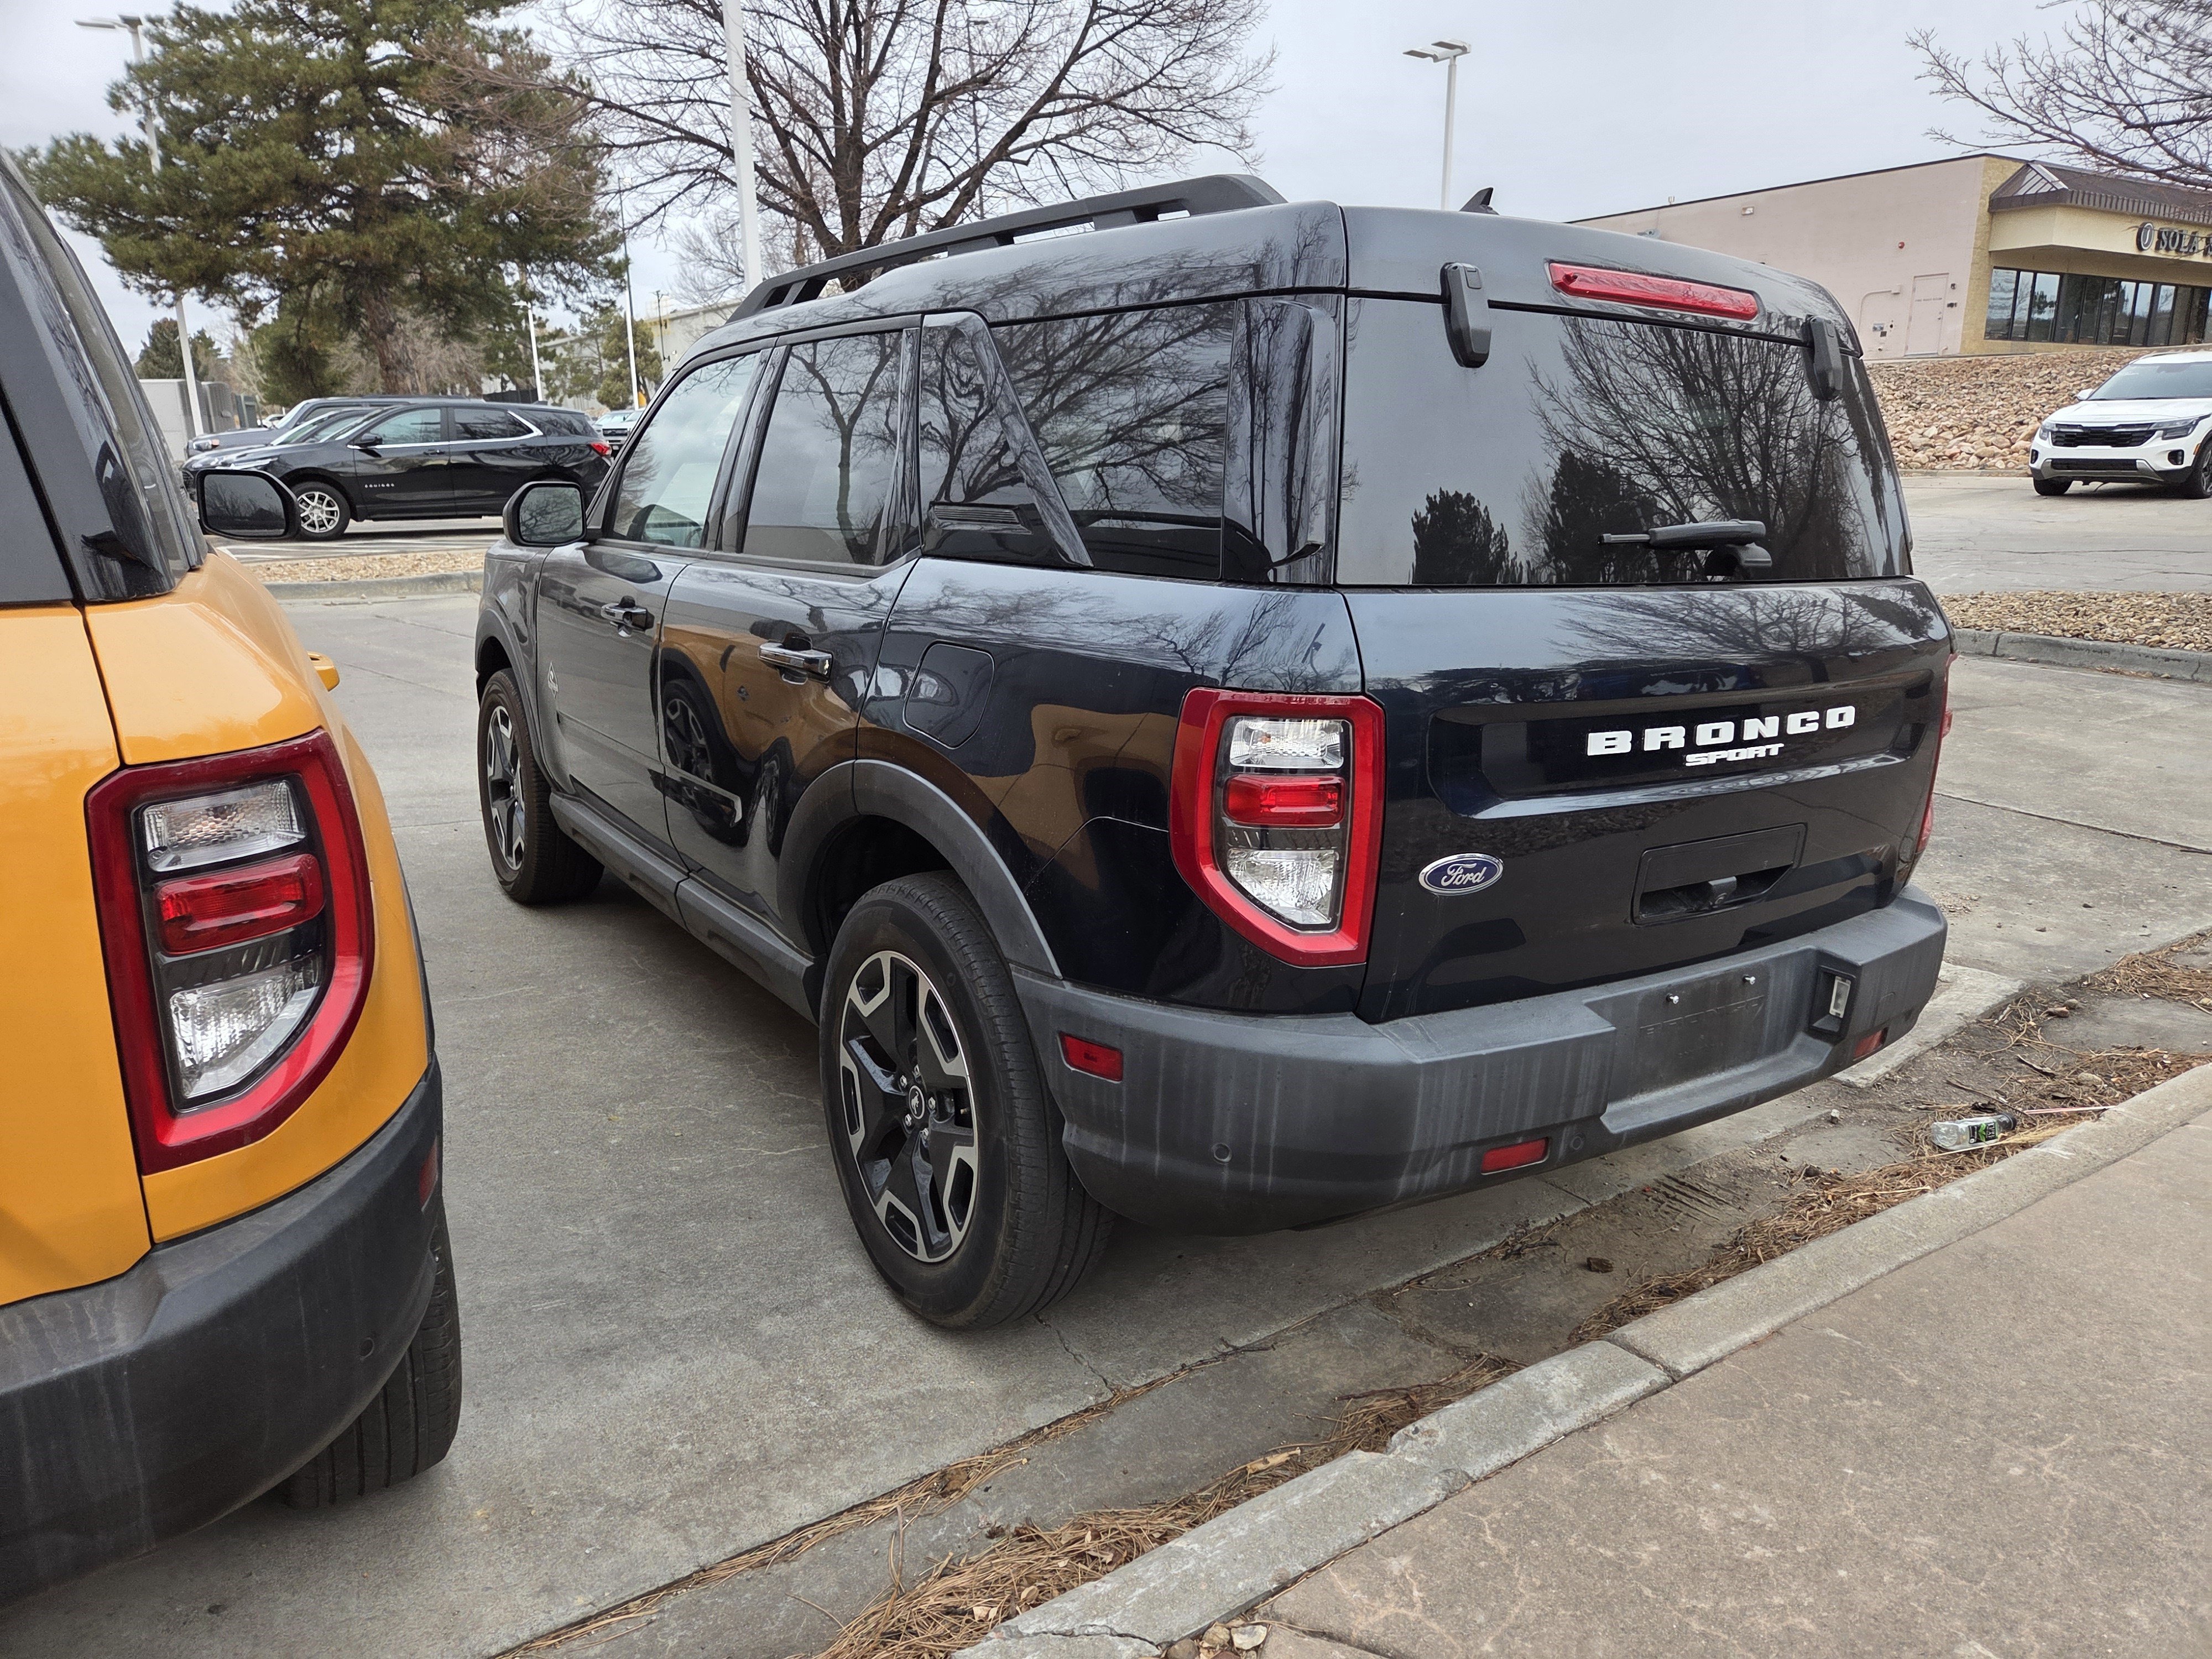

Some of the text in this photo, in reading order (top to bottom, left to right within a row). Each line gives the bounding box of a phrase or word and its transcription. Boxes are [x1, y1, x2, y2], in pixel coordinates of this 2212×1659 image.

[2156, 228, 2199, 253] SOLA
[1586, 705, 1855, 756] BRONCO
[1685, 743, 1784, 766] SPORT
[1441, 863, 1487, 886] Ford
